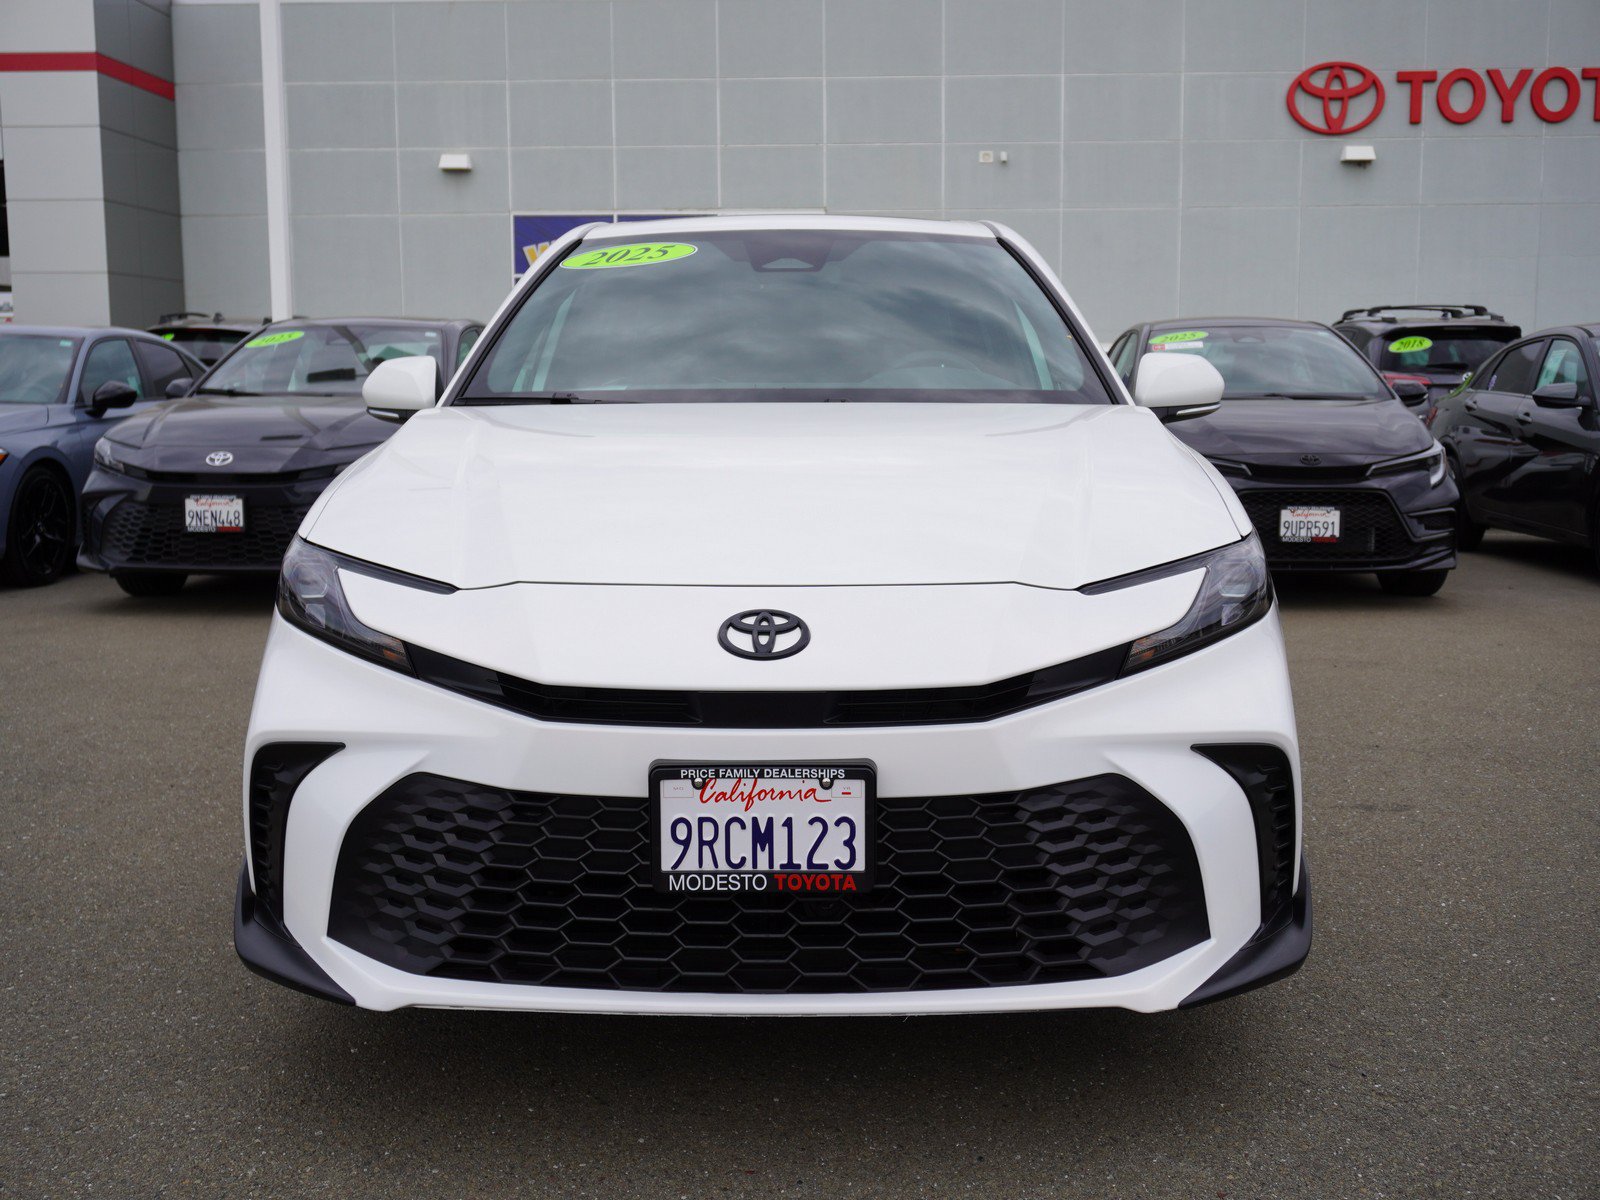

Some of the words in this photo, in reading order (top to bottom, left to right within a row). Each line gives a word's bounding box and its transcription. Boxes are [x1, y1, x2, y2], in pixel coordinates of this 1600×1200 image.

[579, 244, 676, 266] 2025
[188, 509, 241, 528] 9NEN448
[1283, 520, 1336, 538] 9UPR591
[680, 768, 716, 779] PRICE
[719, 768, 760, 778] FAMILY
[764, 768, 845, 779] DEALERSHIPS
[699, 777, 832, 812] California
[670, 816, 857, 870] 9RCM123
[668, 873, 768, 891] MODESTO
[774, 874, 857, 891] TOYOTA
